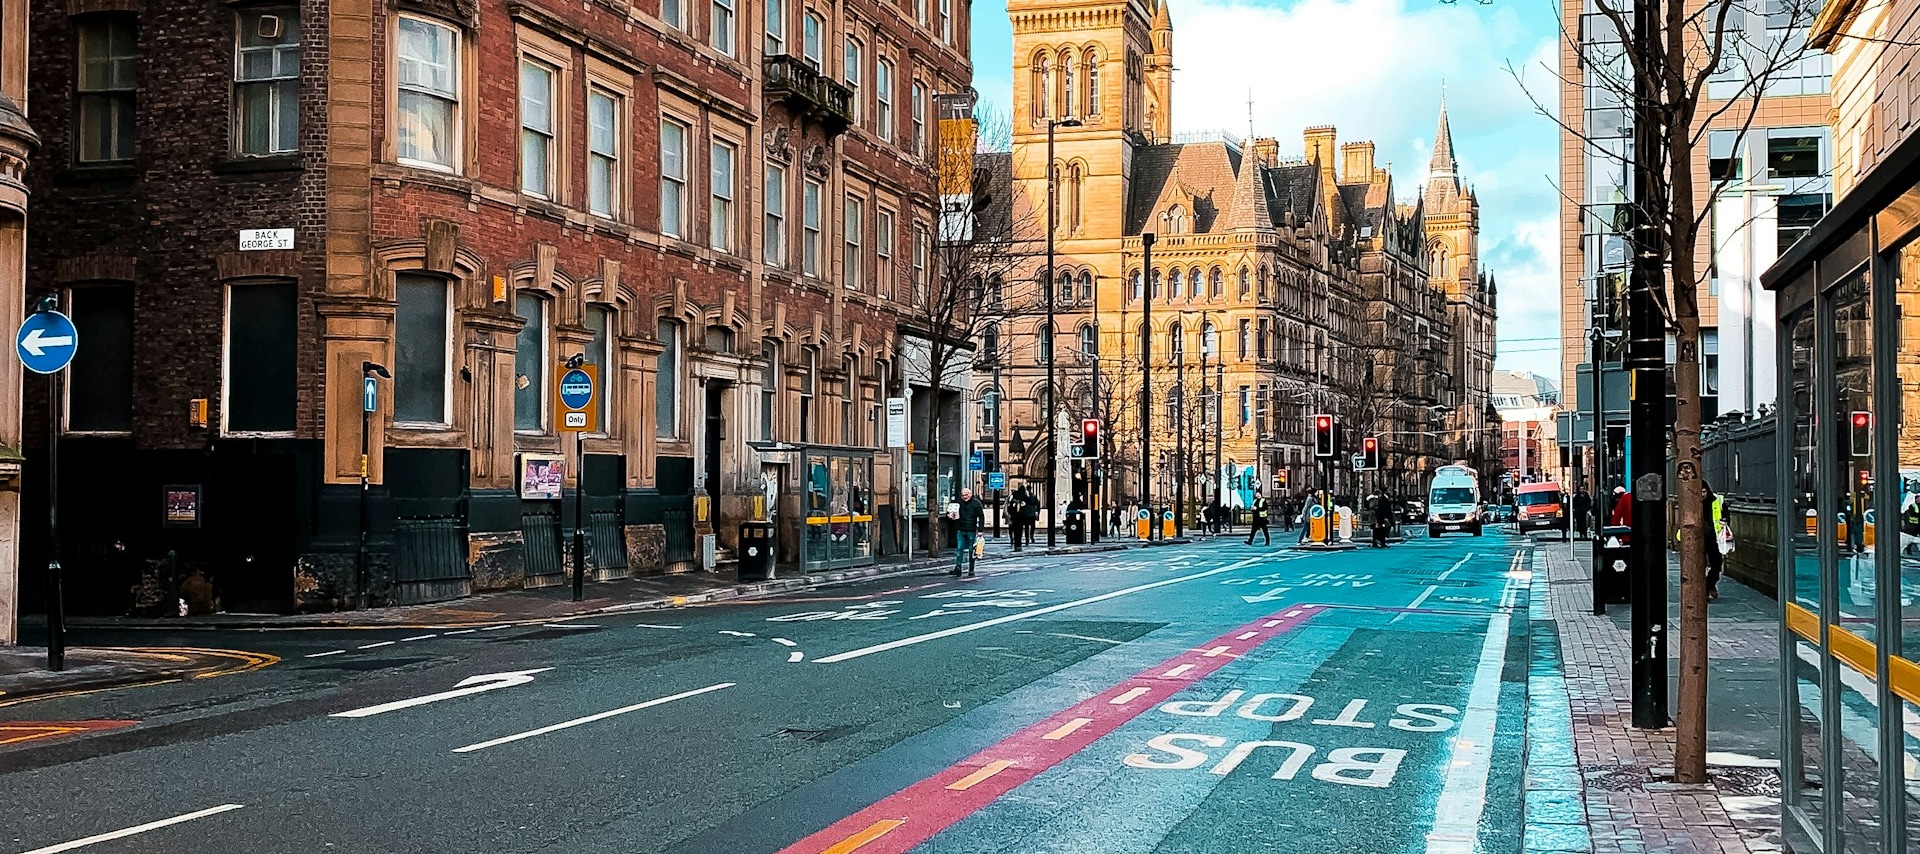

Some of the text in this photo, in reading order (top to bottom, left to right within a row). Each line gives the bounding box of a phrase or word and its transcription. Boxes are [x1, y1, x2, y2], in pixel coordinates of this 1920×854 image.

[255, 230, 279, 239] BACK
[241, 239, 288, 248] GEORGE ST
[568, 416, 584, 424] Only
[918, 588, 1056, 598] BUS
[1159, 689, 1463, 733] STOP
[1122, 732, 1408, 788] BUS
